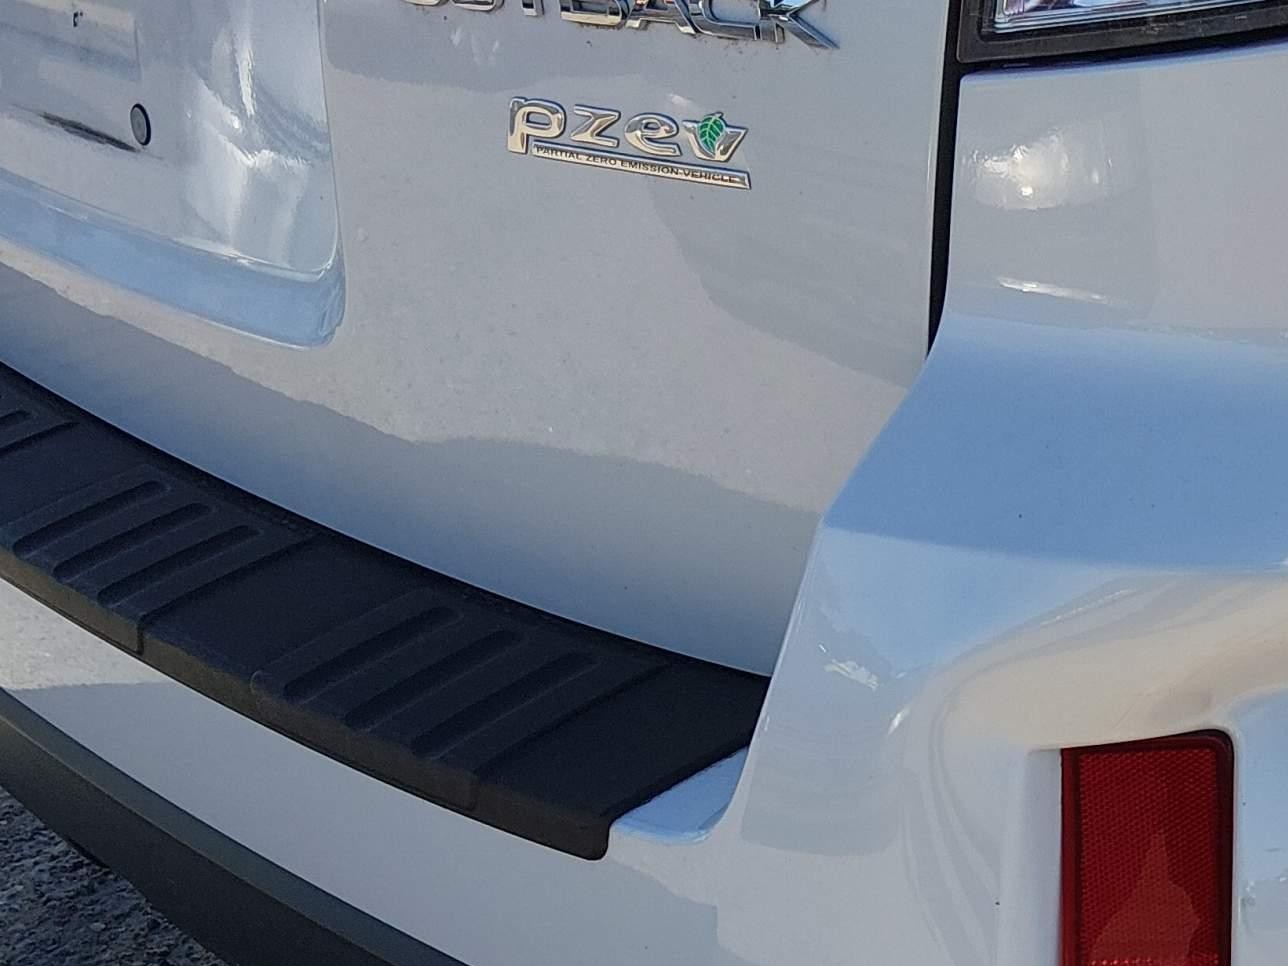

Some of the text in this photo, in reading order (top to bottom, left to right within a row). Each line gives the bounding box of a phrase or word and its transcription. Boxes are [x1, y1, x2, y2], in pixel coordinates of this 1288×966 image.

[535, 145, 738, 184] PARTIAL ZERO EMISSION VEHICLE
